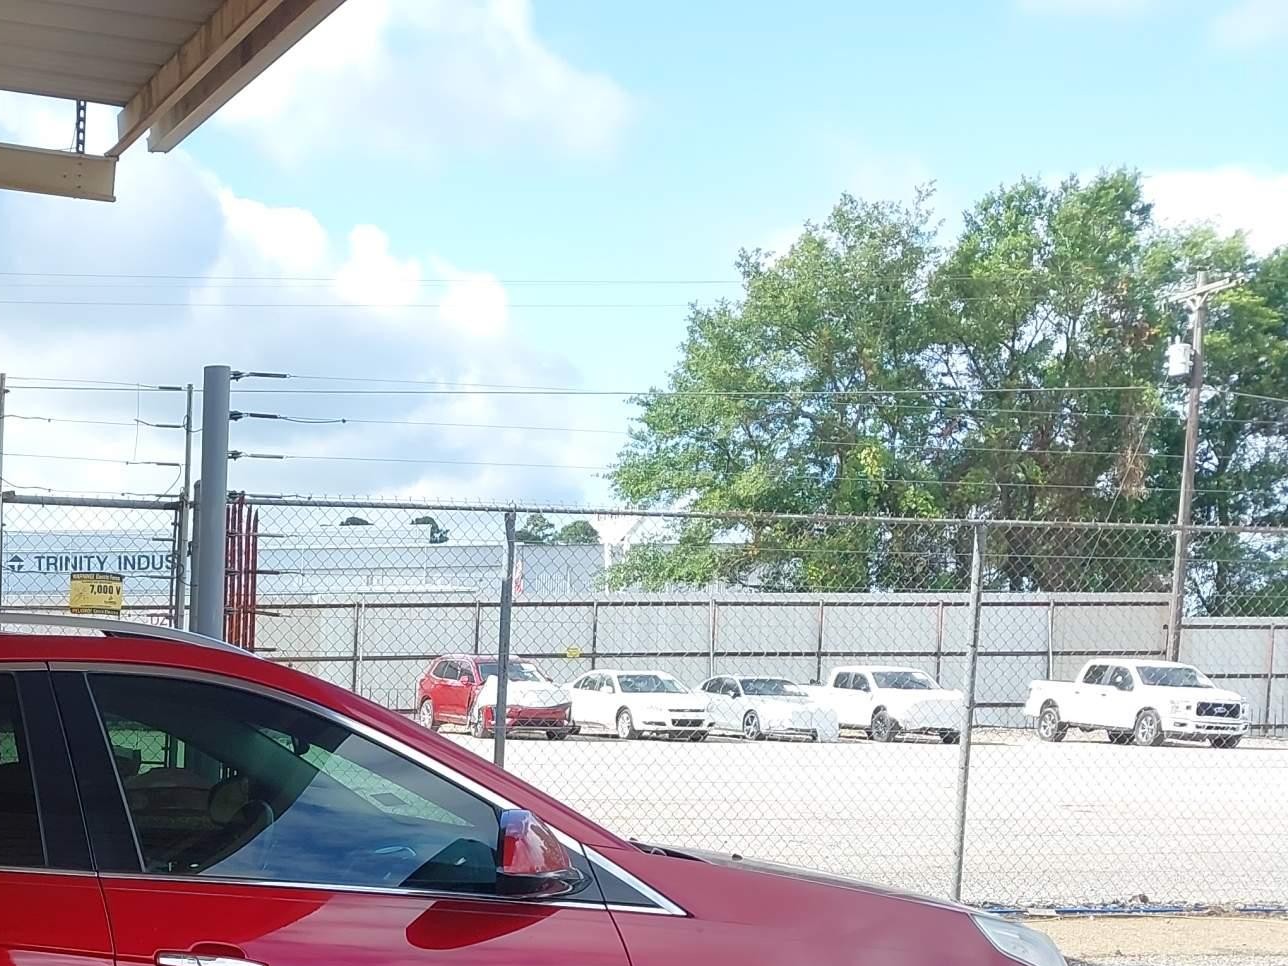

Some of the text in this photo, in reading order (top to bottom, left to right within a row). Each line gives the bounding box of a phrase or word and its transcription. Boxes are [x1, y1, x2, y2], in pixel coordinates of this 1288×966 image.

[34, 555, 108, 571] TRINITY
[89, 584, 121, 596] 7,000 V
